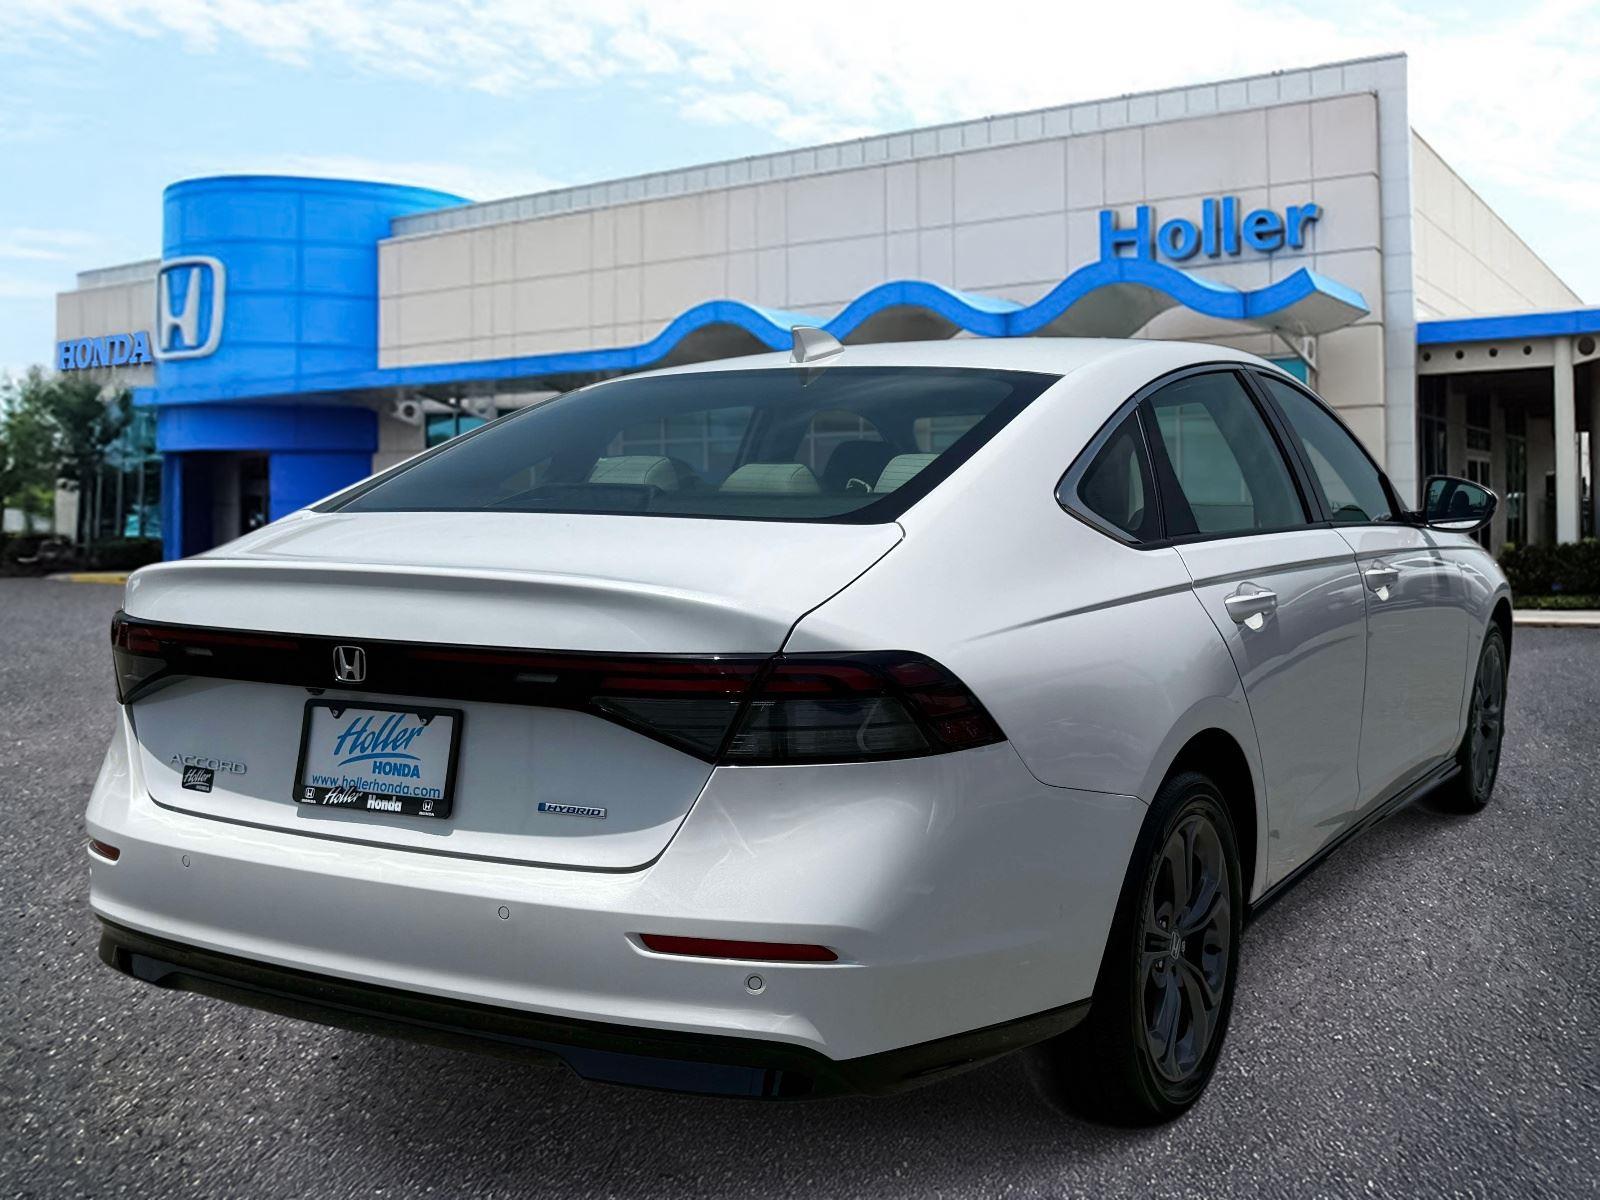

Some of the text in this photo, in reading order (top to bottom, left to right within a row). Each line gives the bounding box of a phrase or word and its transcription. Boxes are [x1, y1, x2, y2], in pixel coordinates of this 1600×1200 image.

[1099, 196, 1322, 262] Holler
[58, 331, 152, 370] HONDA
[334, 713, 425, 755] Holler
[170, 753, 247, 775] ACCORD
[184, 768, 211, 783] Holler
[372, 761, 420, 779] HONDA
[312, 774, 441, 798] www.hollerhonda.com
[322, 786, 402, 812] Holler Honda
[547, 804, 601, 816] HYBRID
